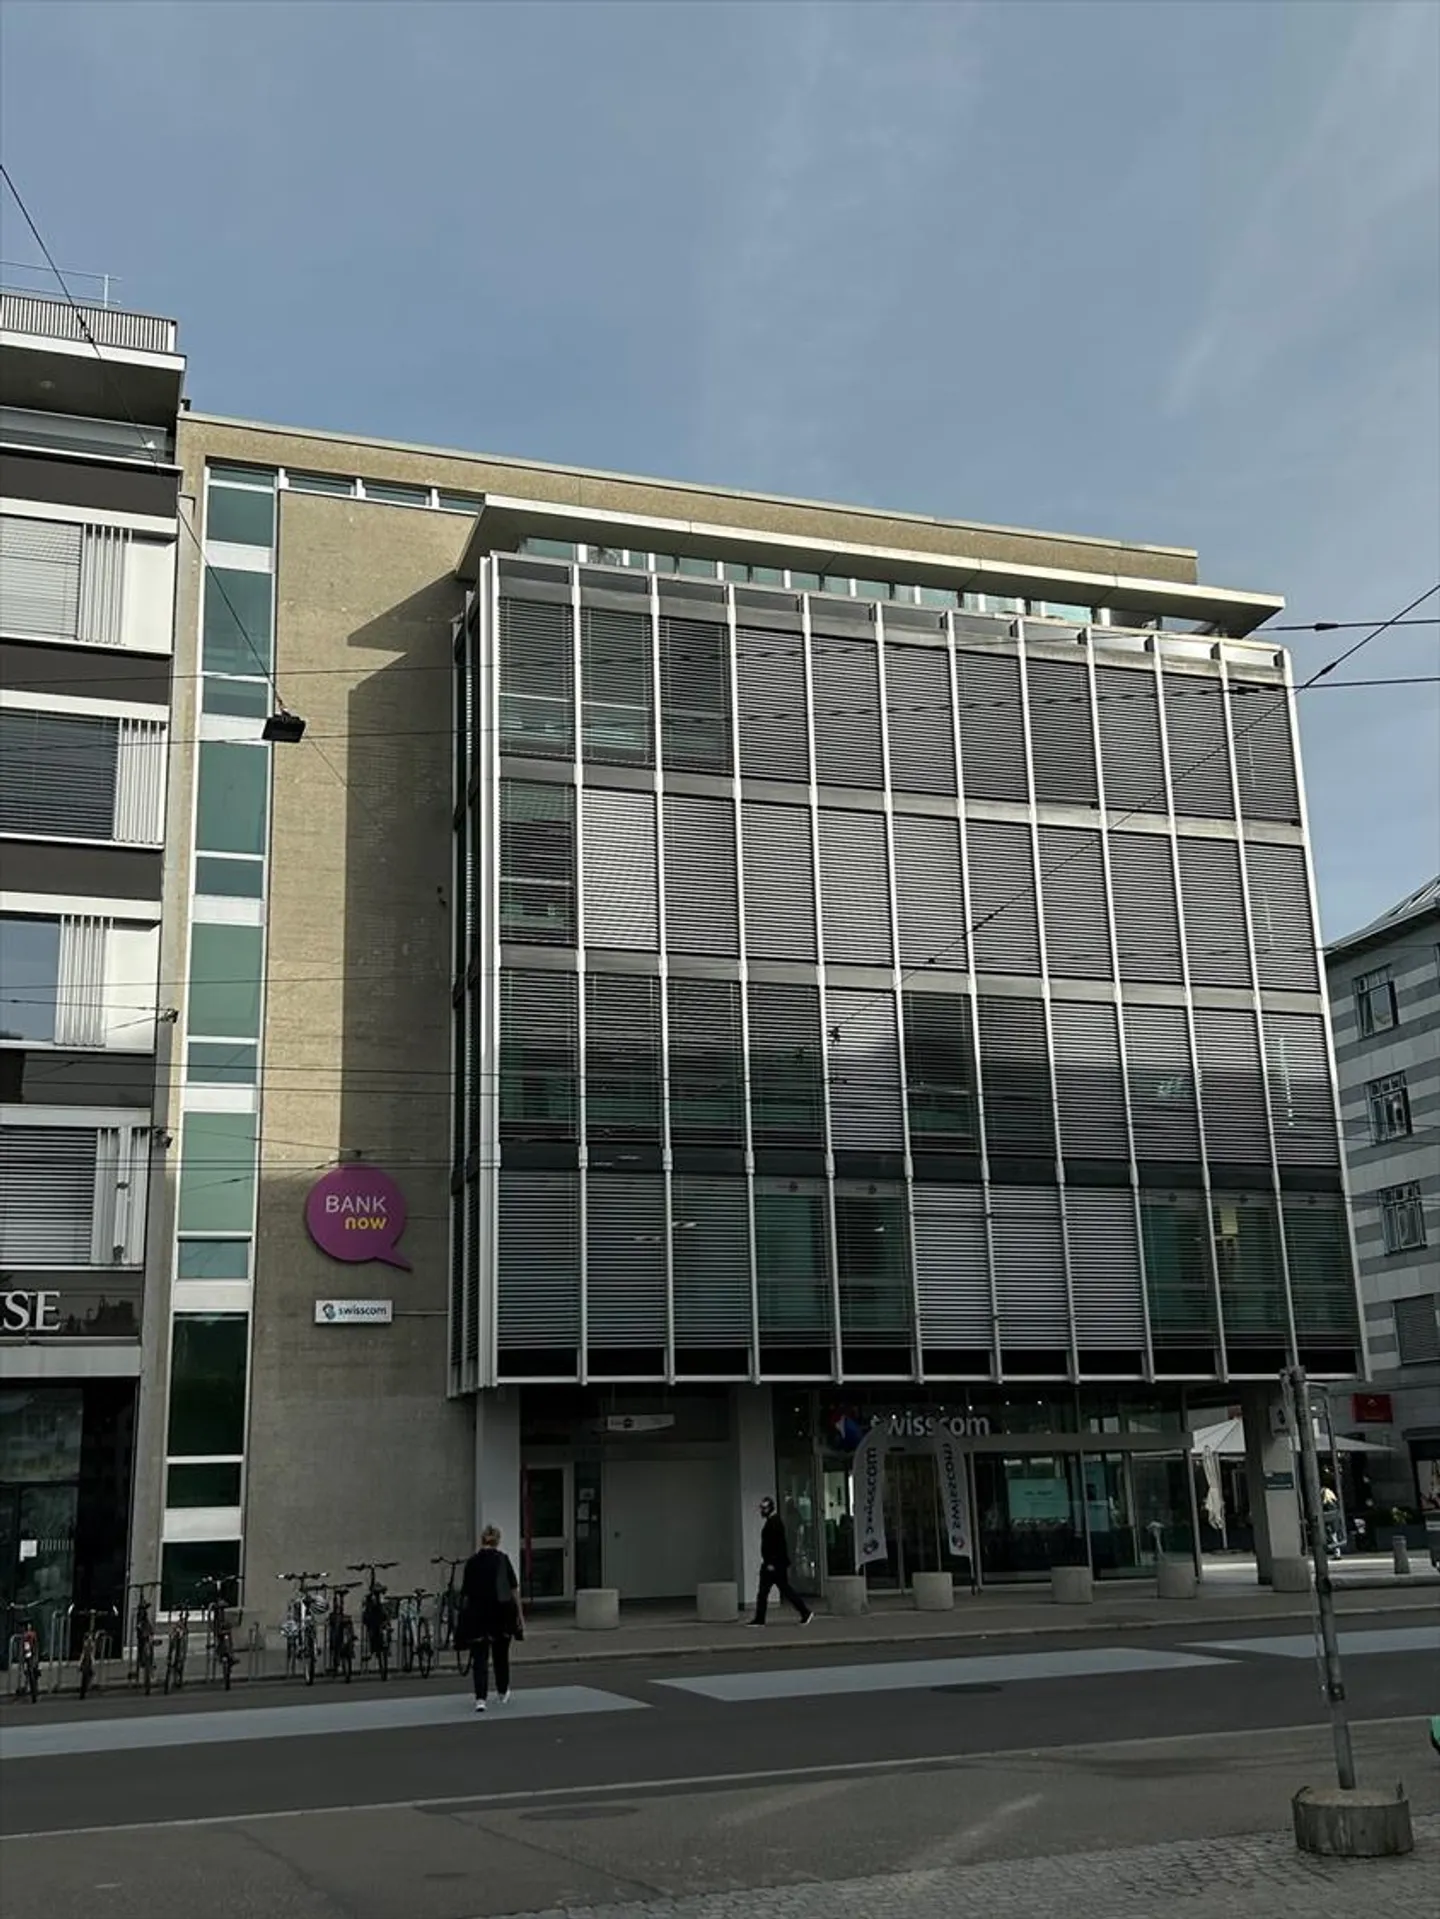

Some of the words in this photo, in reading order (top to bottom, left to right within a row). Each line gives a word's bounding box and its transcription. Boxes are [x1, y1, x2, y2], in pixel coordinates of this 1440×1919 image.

[325, 1195, 387, 1213] BANK
[344, 1216, 387, 1230] now
[338, 1303, 387, 1316] swisscom
